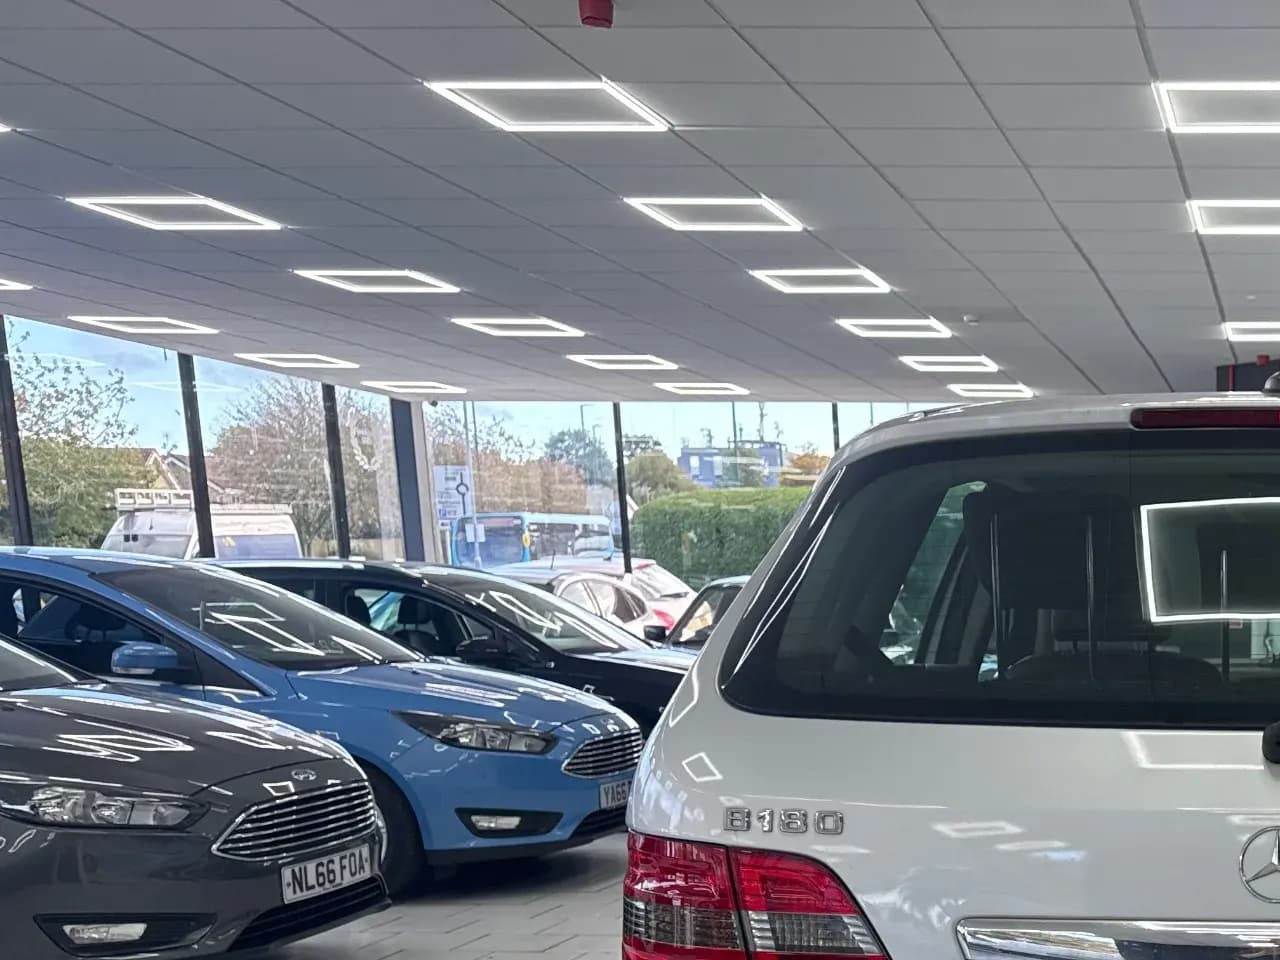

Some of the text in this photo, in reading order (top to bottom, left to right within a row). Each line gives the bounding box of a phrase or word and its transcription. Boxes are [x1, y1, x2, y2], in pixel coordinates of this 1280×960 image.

[723, 807, 844, 835] B180
[291, 848, 366, 895] NL66 FOA
